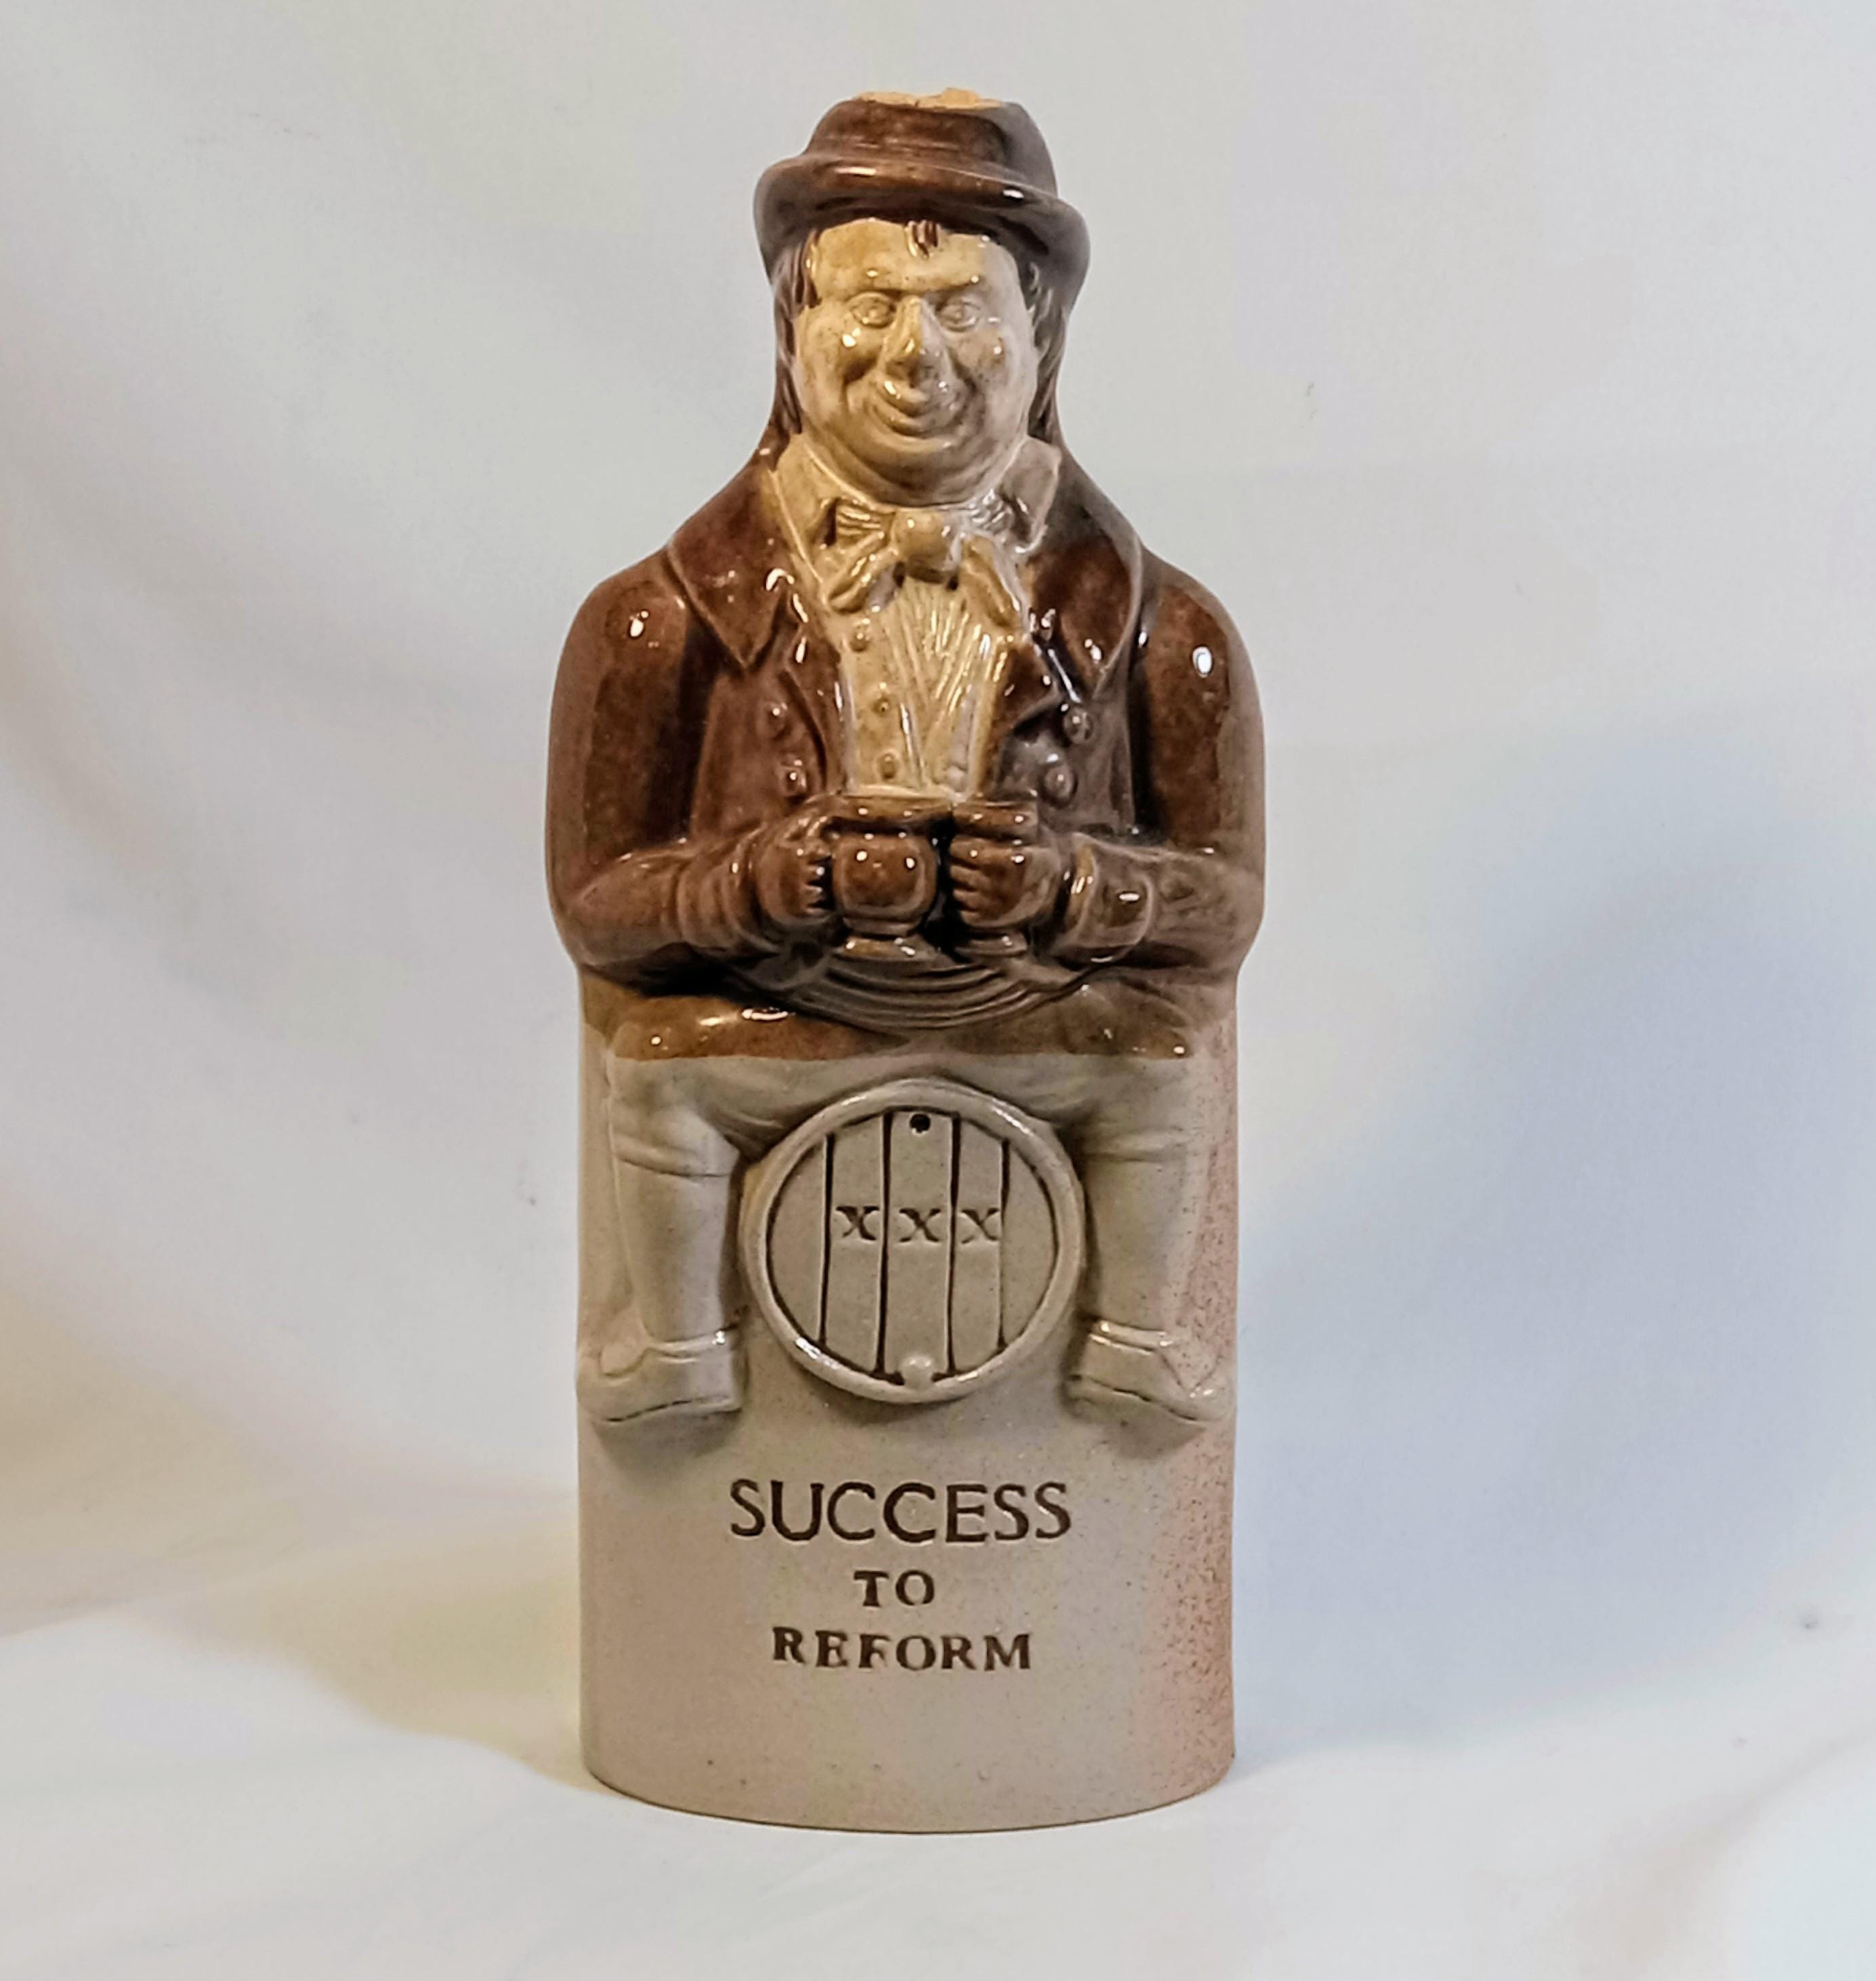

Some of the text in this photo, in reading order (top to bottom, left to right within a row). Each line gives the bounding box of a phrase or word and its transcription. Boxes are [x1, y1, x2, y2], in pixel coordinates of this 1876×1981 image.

[729, 1478, 1072, 1543] SUCCESS
[853, 1569, 935, 1608] TO
[772, 1626, 1031, 1671] REFORM
